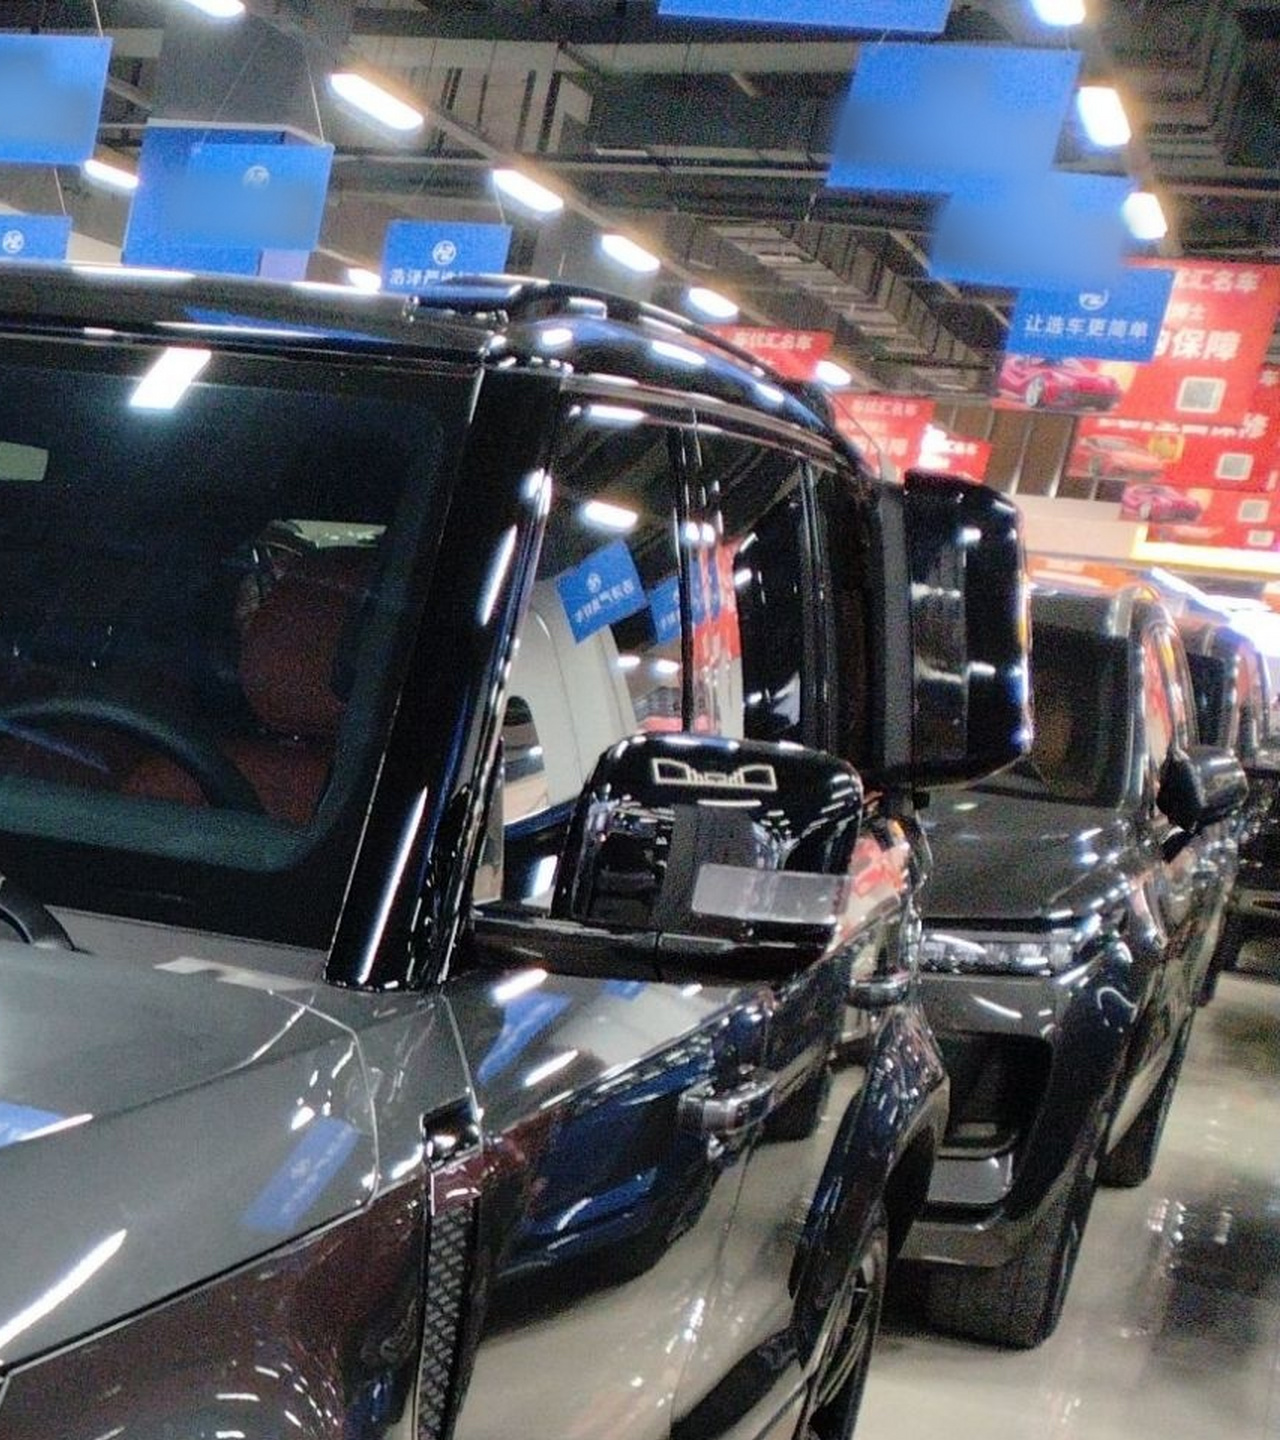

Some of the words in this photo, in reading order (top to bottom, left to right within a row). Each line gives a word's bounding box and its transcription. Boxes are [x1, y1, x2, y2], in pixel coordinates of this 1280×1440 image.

[1023, 313, 1150, 339] 让选车更简单
